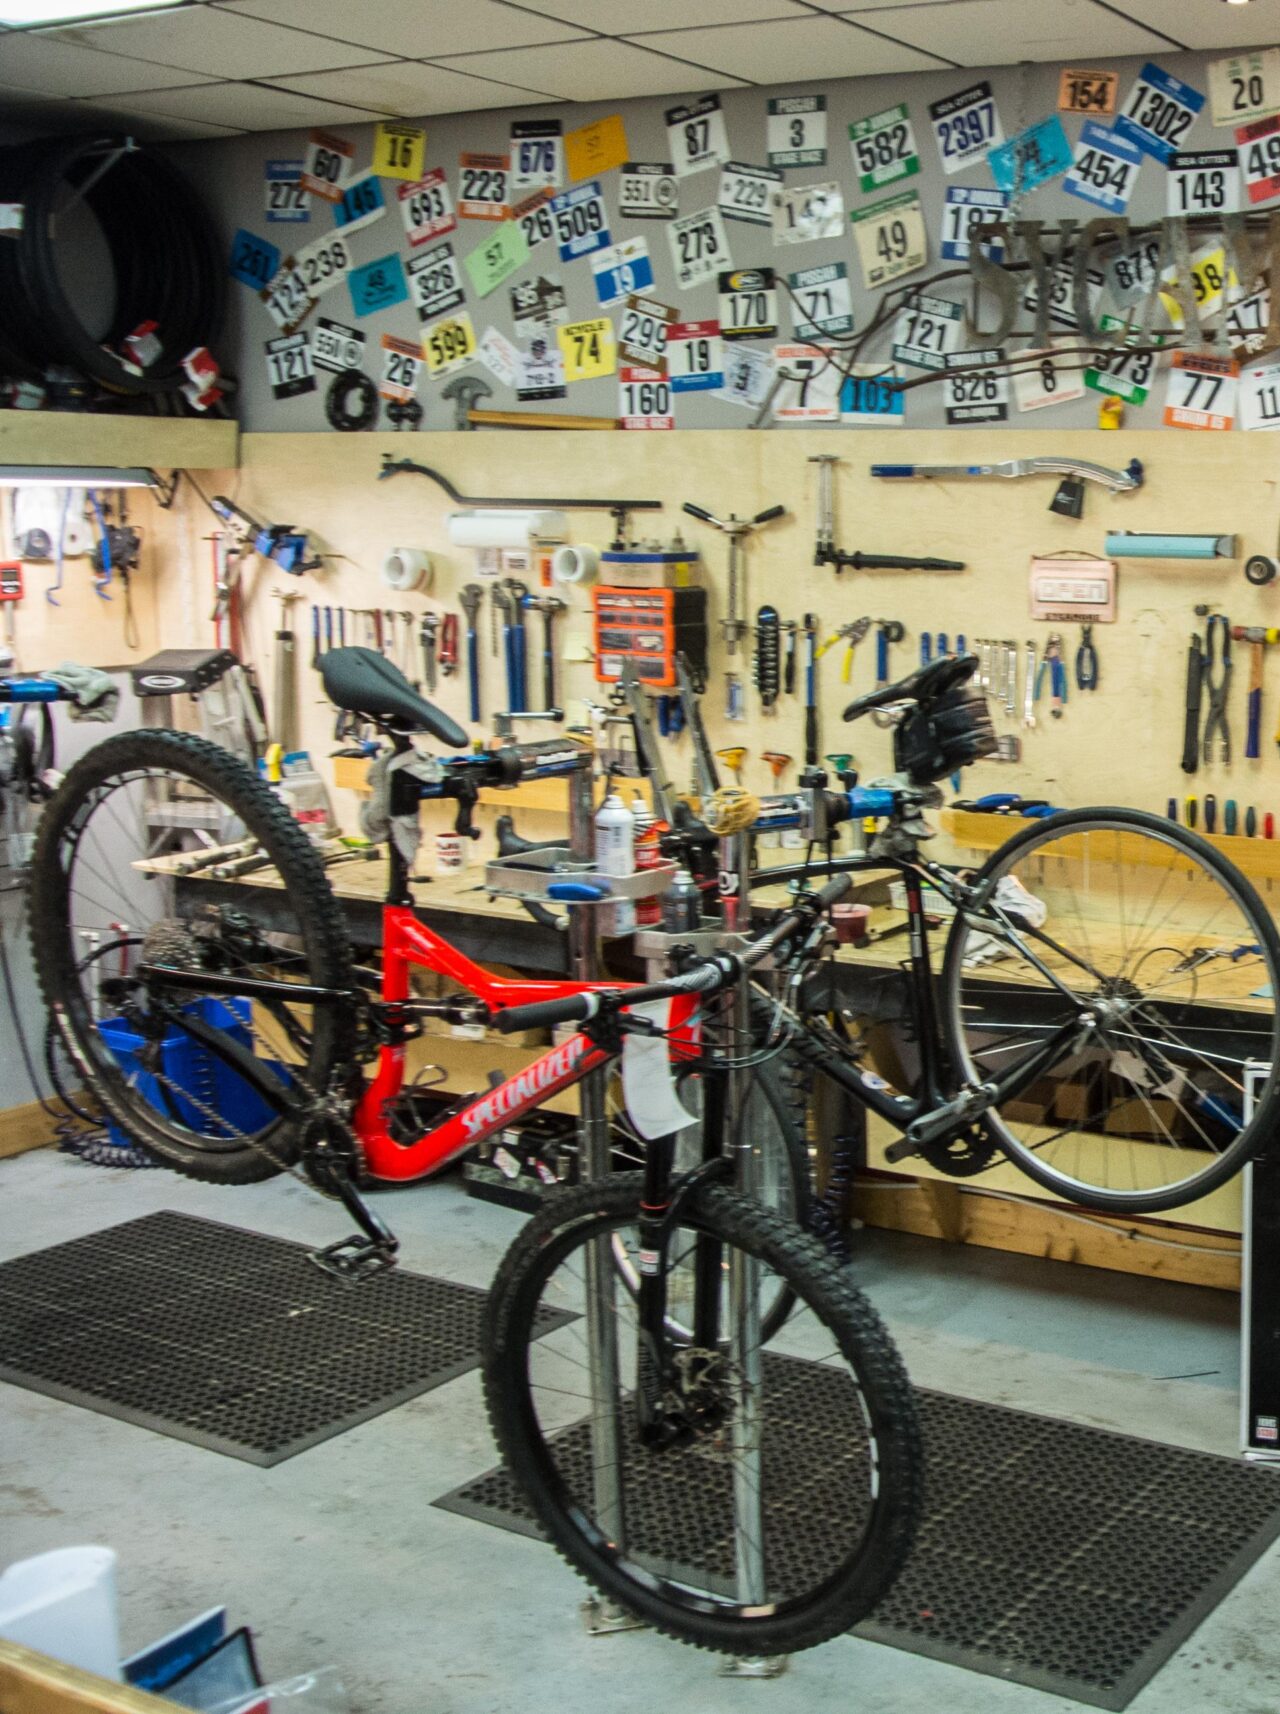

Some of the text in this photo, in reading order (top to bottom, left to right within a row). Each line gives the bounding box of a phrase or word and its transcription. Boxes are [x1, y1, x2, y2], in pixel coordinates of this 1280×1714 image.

[1231, 76, 1263, 110] 20
[790, 119, 804, 147] 3
[938, 102, 995, 157] 2397
[1128, 86, 1194, 147] 1302
[685, 119, 709, 156] 87
[856, 124, 912, 172] 582
[314, 148, 341, 183] 60
[519, 141, 555, 174] 676
[1076, 149, 1132, 194] 454
[270, 183, 306, 209] 272
[463, 169, 506, 202] 223
[1176, 171, 1225, 210] 143
[410, 188, 443, 226] 693
[555, 200, 603, 242] 509
[521, 207, 553, 248] 26
[679, 222, 720, 263] 273
[877, 221, 908, 262] 49
[303, 242, 347, 285] 238
[417, 264, 455, 300] 328
[610, 268, 636, 298] 19
[728, 291, 768, 327] 170
[805, 287, 834, 319] 71
[429, 324, 468, 366] 599
[574, 334, 601, 367] 74
[622, 313, 668, 354] 299
[905, 316, 946, 351] 121
[271, 348, 308, 383] 121
[386, 353, 416, 387] 26
[686, 339, 710, 373] 19
[796, 361, 813, 408] 7
[952, 371, 998, 403] 826
[1041, 359, 1056, 392] 8
[1181, 371, 1224, 411] 77
[623, 382, 670, 416] 160
[851, 379, 895, 413] 103
